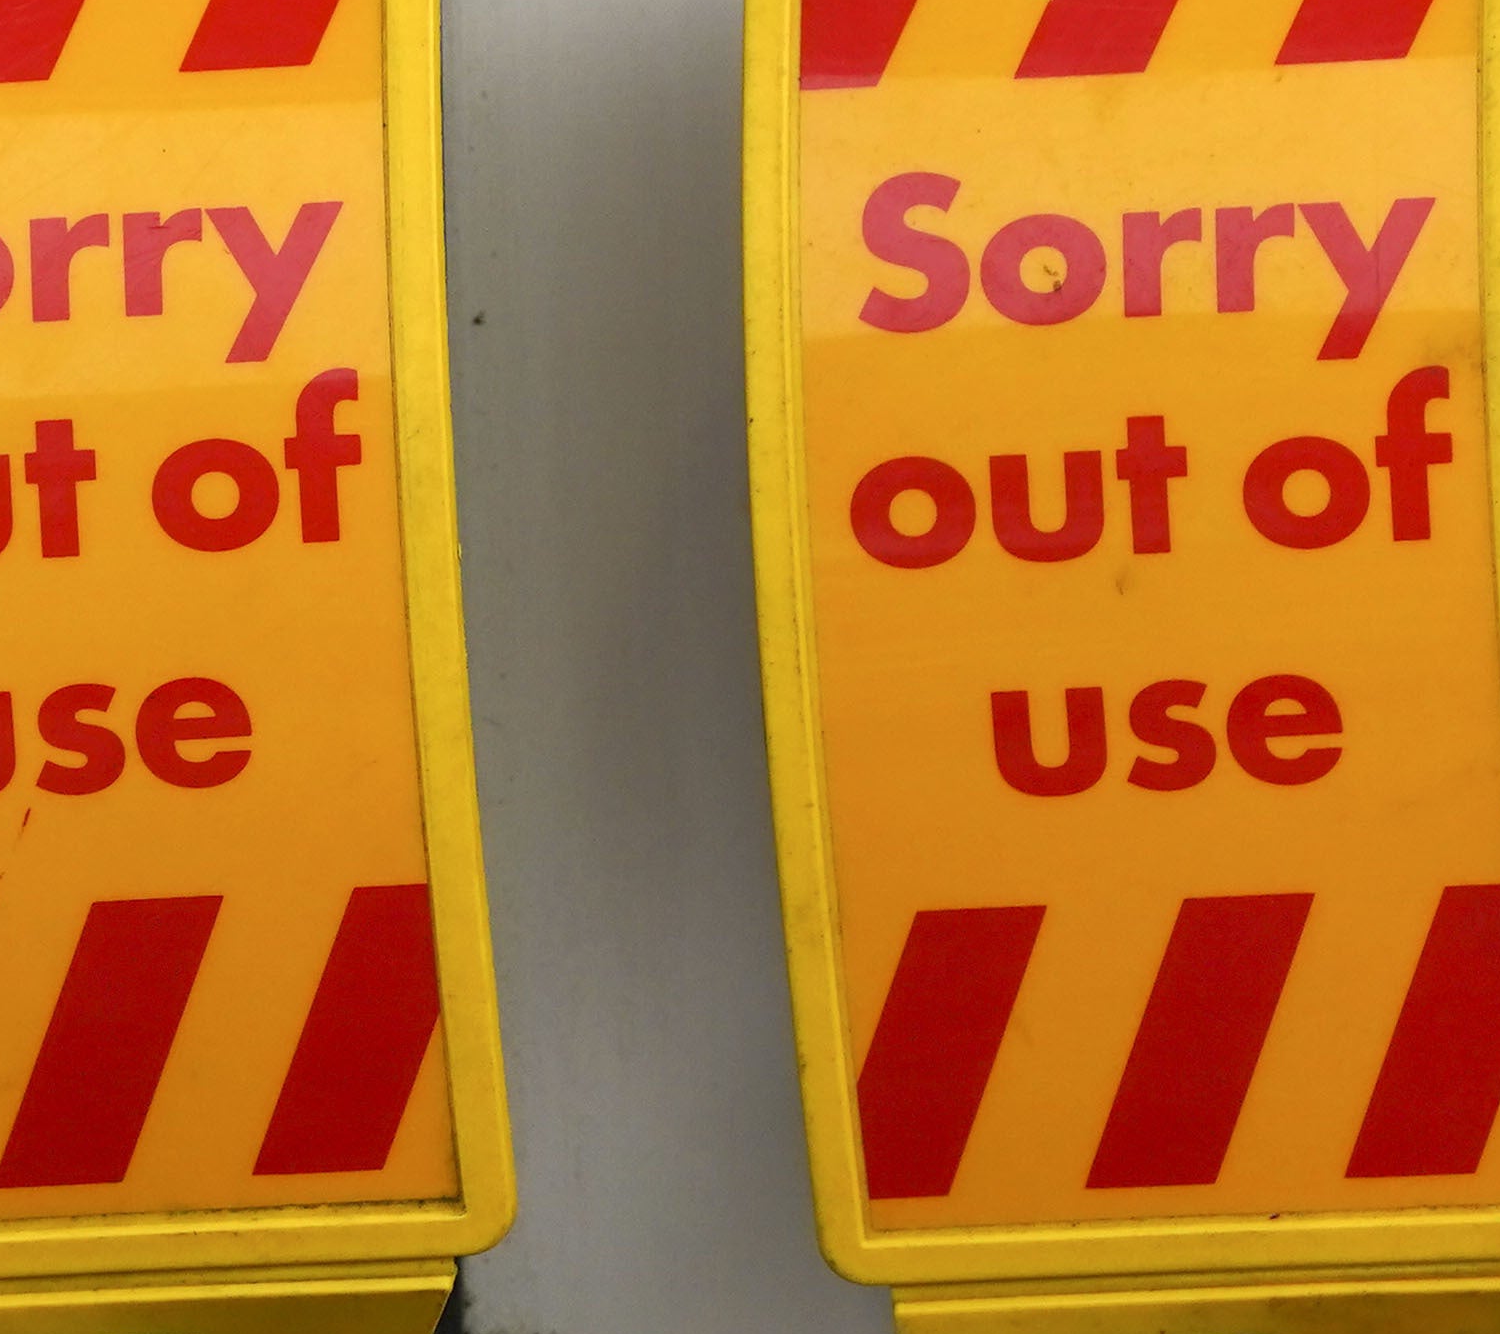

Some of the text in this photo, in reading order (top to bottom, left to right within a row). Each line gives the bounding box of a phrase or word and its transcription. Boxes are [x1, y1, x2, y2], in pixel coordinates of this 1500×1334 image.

[859, 172, 1435, 362] Sorry
[150, 367, 364, 554] of
[849, 365, 1455, 571] out of
[989, 672, 1345, 799] use
